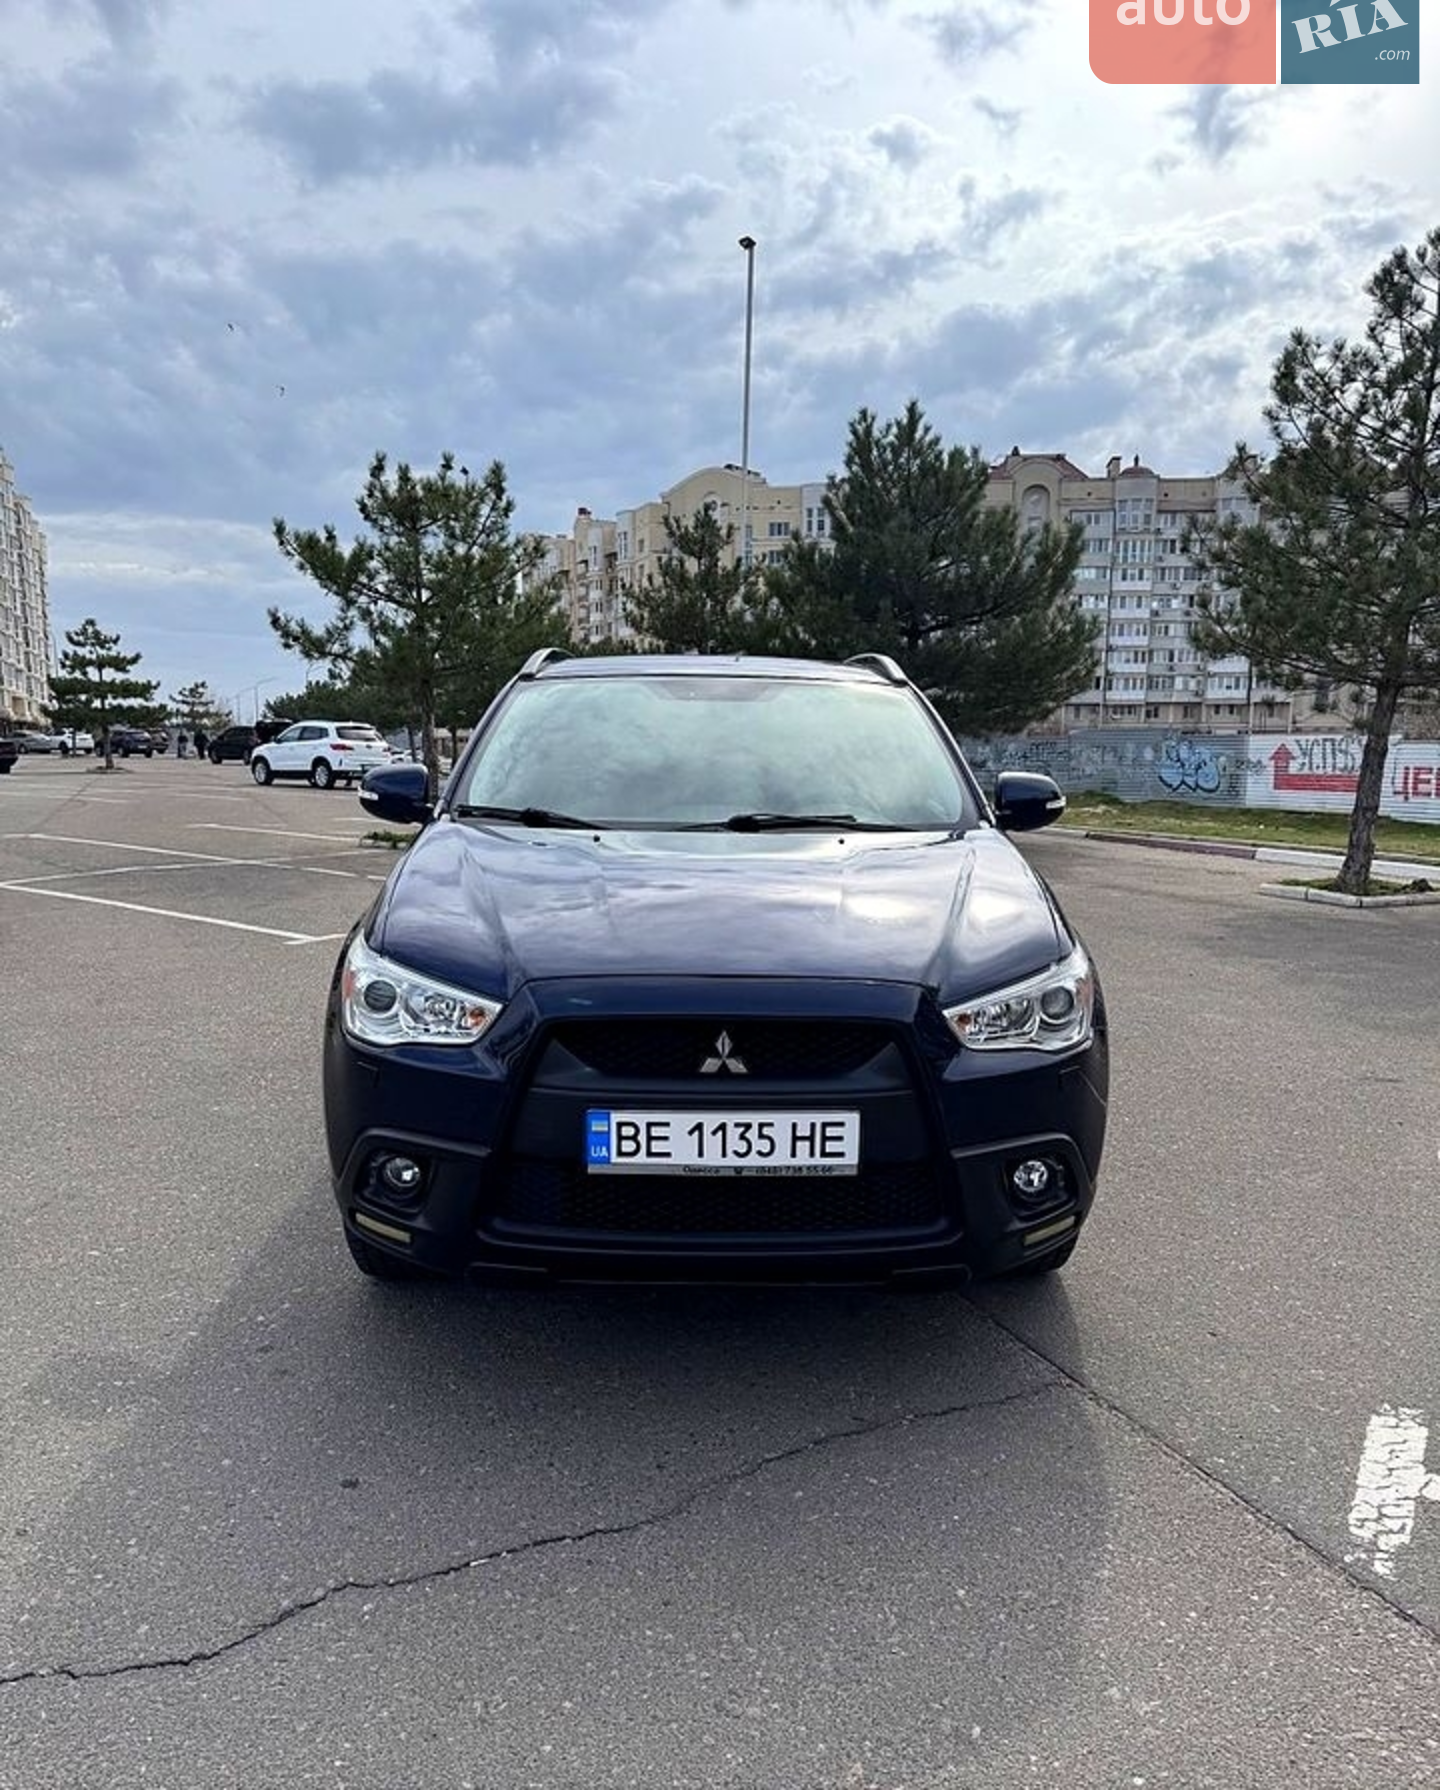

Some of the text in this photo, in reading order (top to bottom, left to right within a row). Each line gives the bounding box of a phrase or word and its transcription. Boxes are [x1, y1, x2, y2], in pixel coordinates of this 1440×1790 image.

[616, 1121, 846, 1158] BE 1135 HE
[591, 1146, 608, 1158] UA
